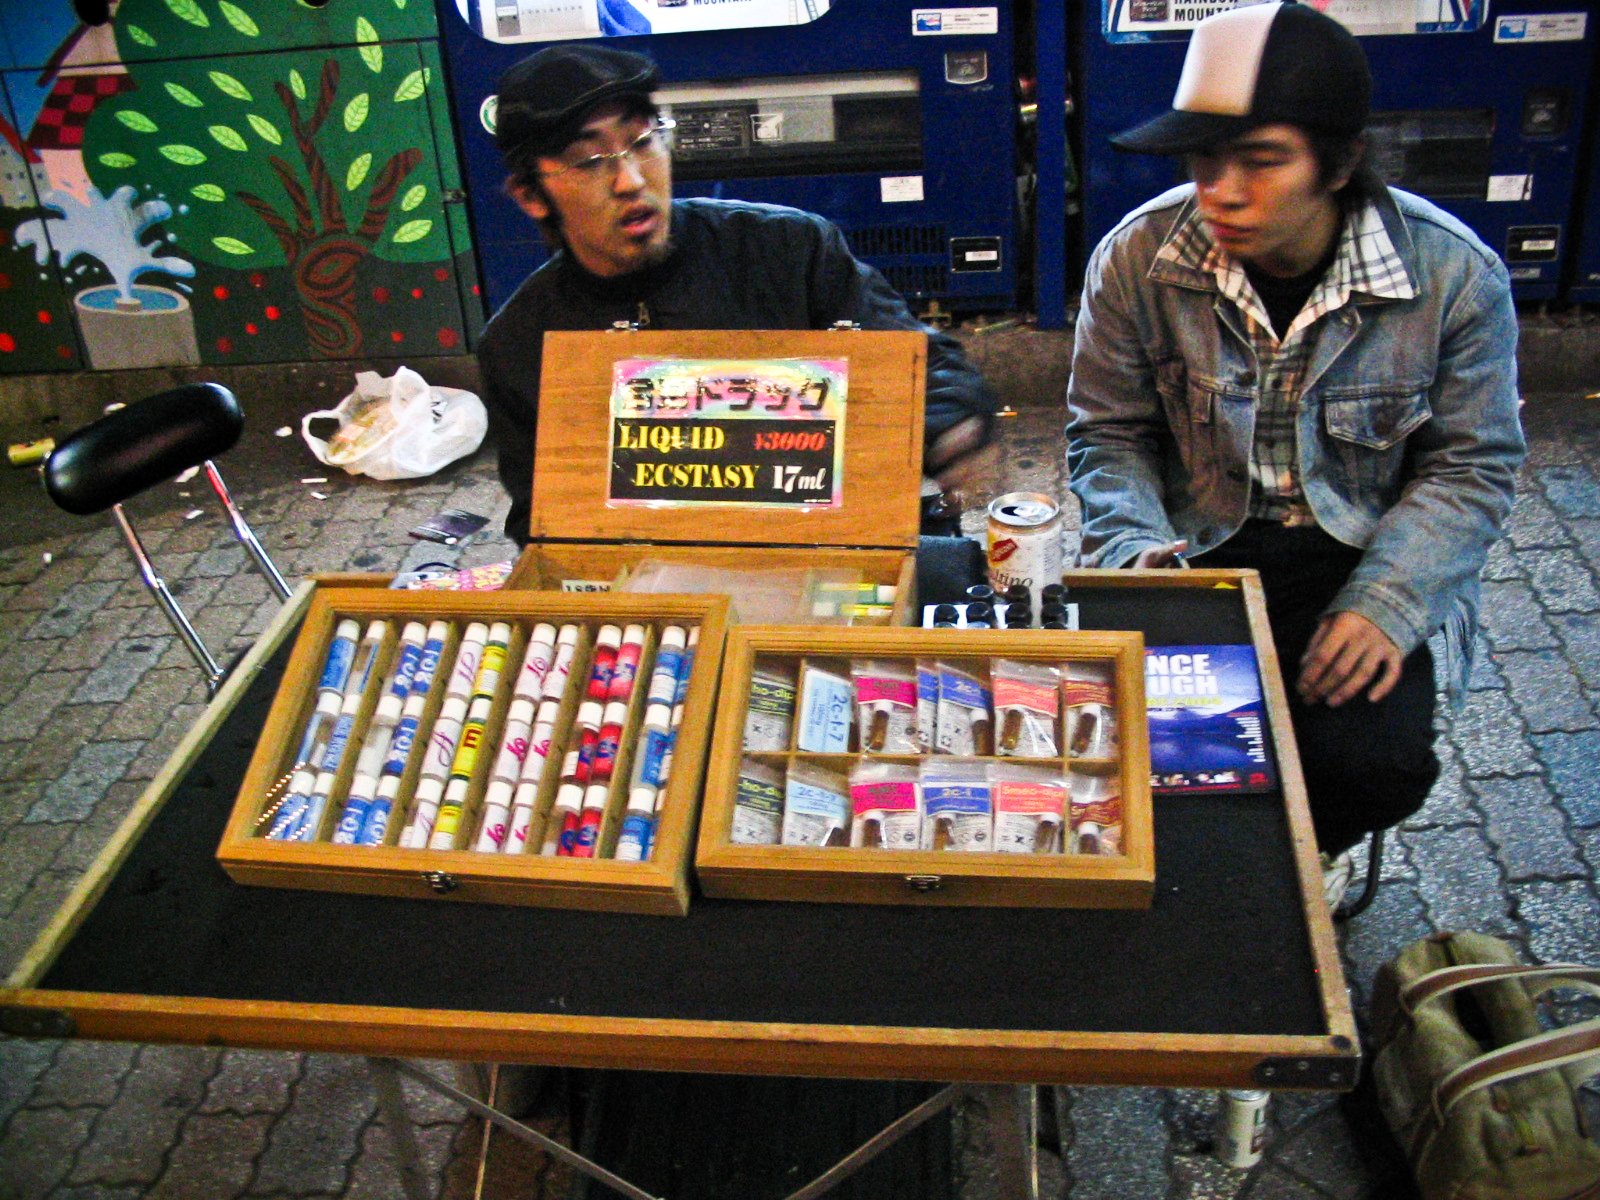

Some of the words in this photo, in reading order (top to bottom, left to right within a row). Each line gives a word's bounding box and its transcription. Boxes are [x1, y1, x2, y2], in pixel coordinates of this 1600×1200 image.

[619, 425, 725, 453] LIQUID
[634, 463, 760, 489] ECSTASY
[772, 465, 826, 493] 17ml
[1146, 654, 1211, 675] NCE
[1148, 675, 1218, 696] UGH
